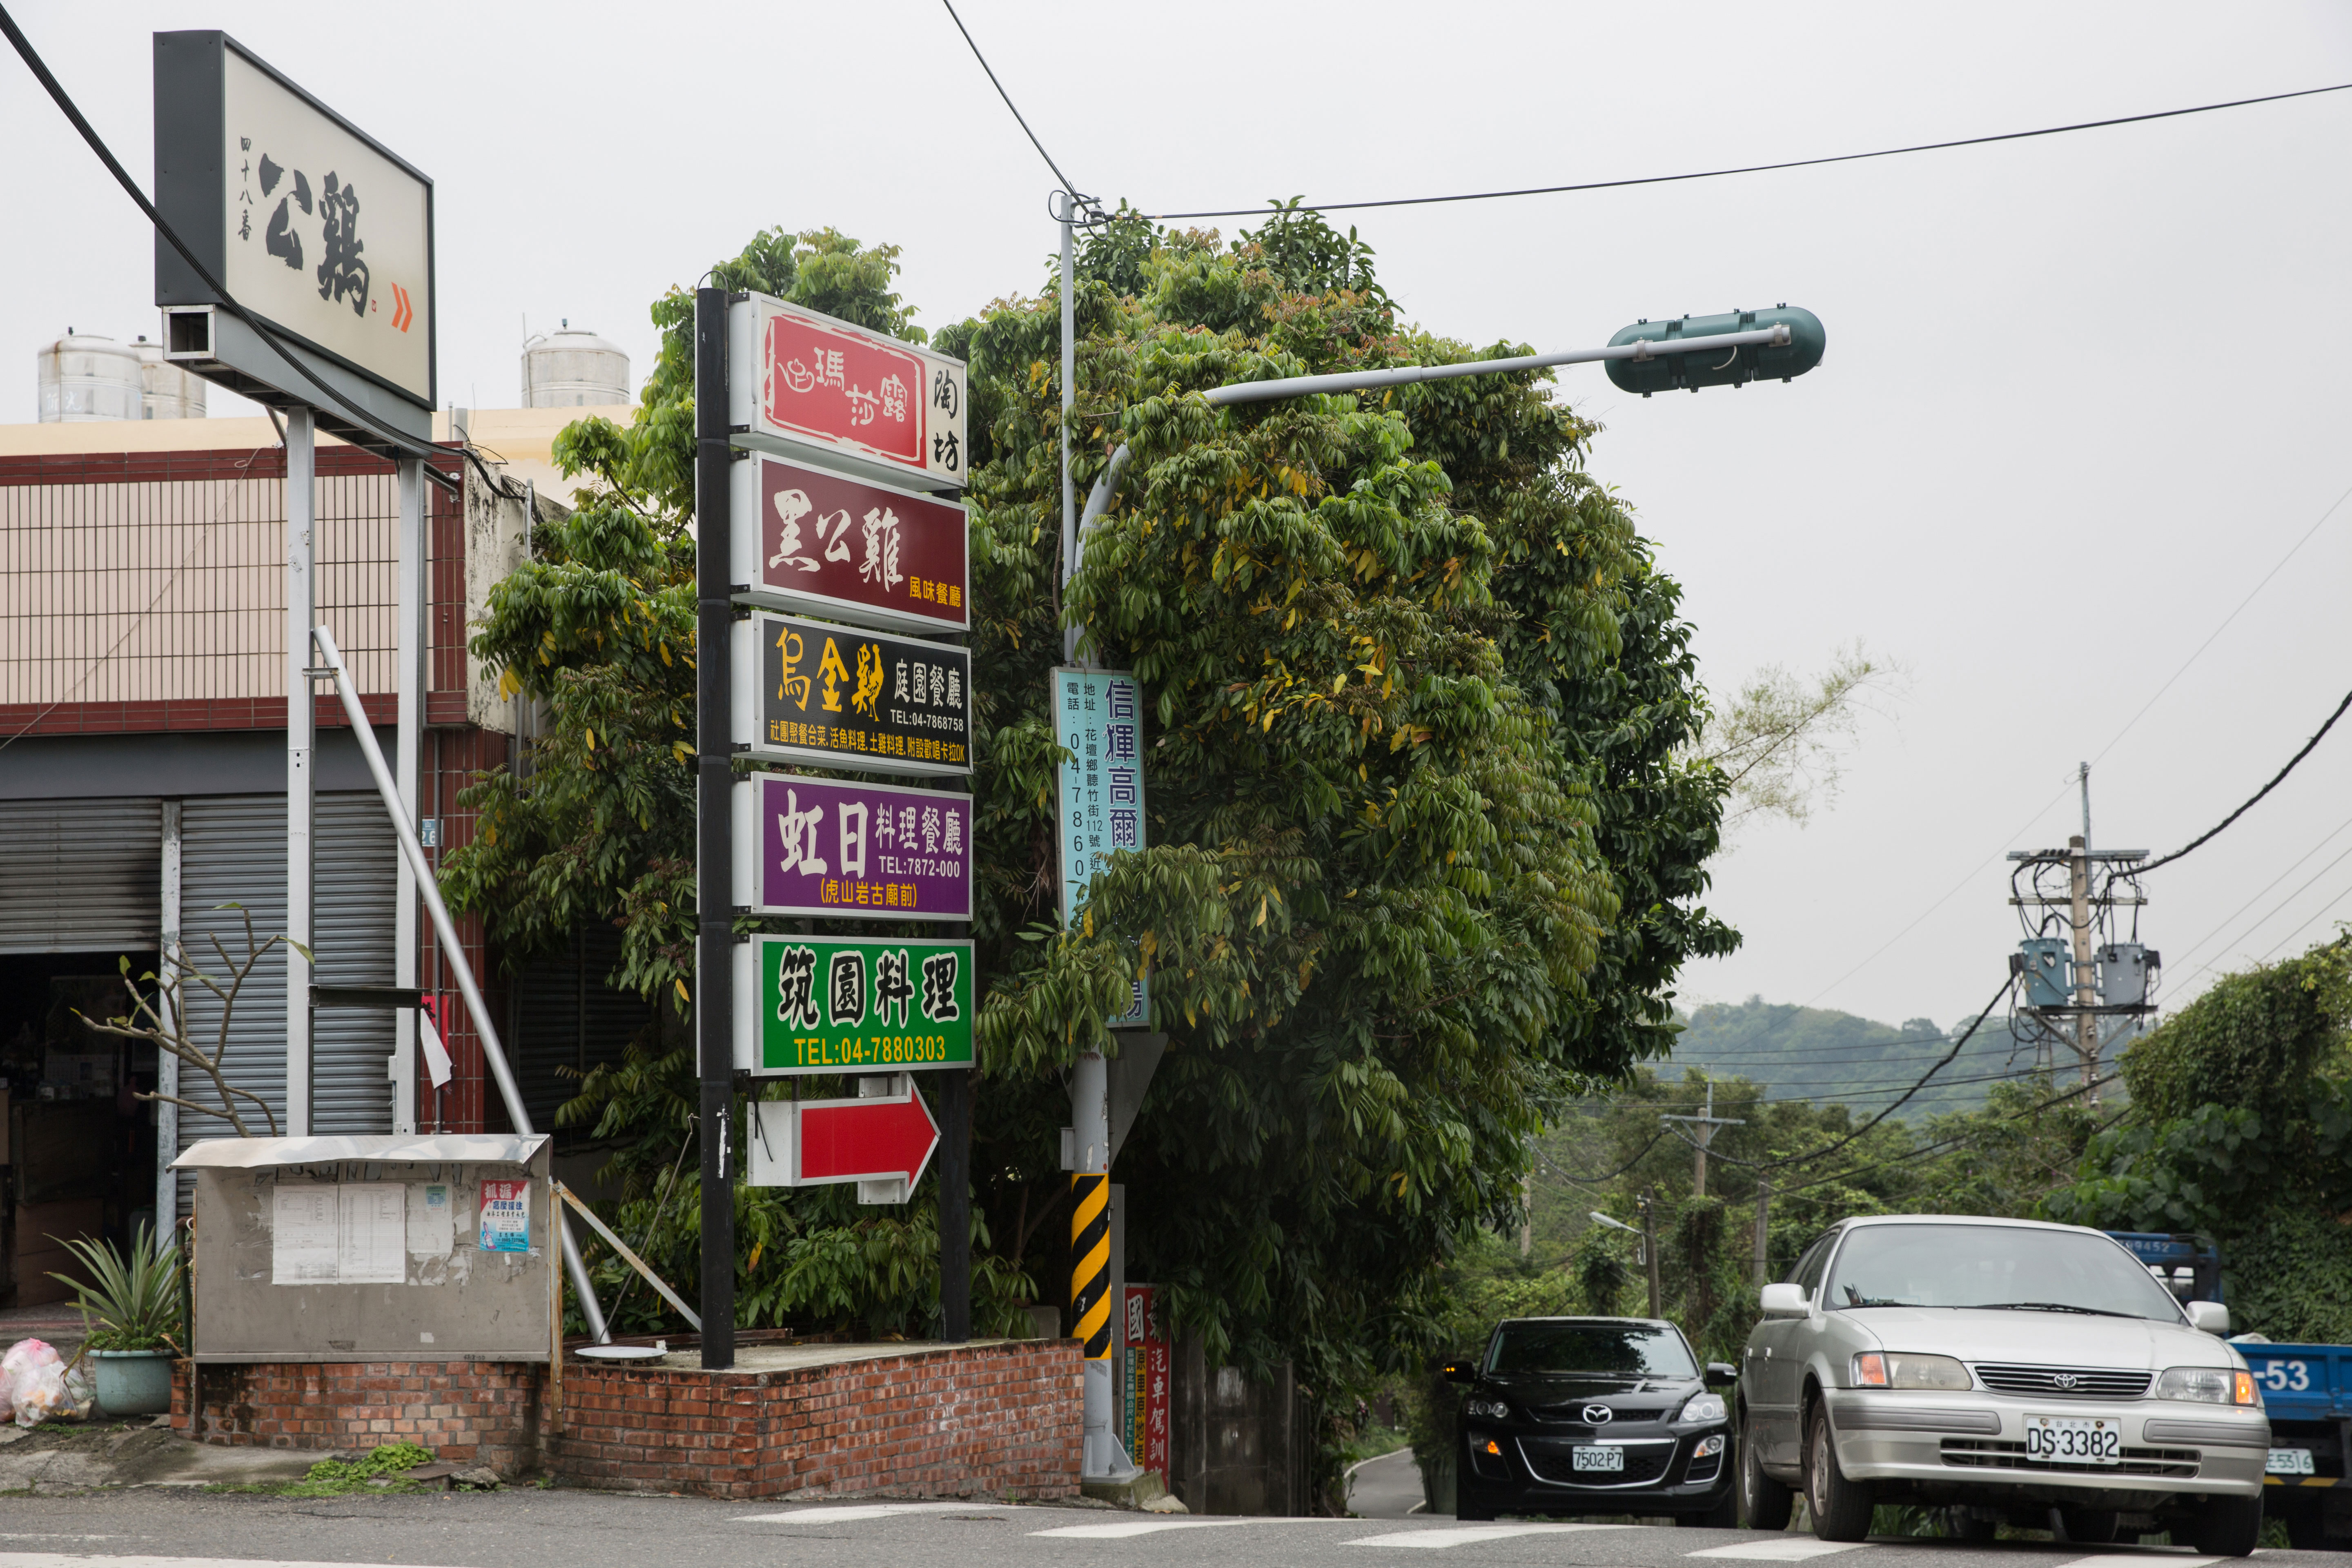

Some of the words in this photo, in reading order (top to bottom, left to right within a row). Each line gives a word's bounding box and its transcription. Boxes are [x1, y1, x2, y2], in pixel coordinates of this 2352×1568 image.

[238, 136, 253, 241] 四十八番
[814, 347, 908, 426] 瑪莎露
[933, 369, 959, 472] 陶坊
[909, 576, 961, 607] 風味餐廳
[894, 658, 962, 710] 庭園餐廳
[890, 709, 964, 732] TEL:04-7868758
[778, 788, 869, 879] 虹日
[875, 802, 963, 855] 料理餐廳
[820, 878, 917, 908] (虎山岩古廟前)
[878, 855, 960, 878] TEL:7872-000
[777, 944, 959, 1031] 筑園料理
[794, 1036, 946, 1065] TEL:04-7880303
[485, 1183, 512, 1199] 抓漏
[1136, 1349, 1146, 1465] 原車原地考
[1149, 1348, 1167, 1473] 汽車駕訓
